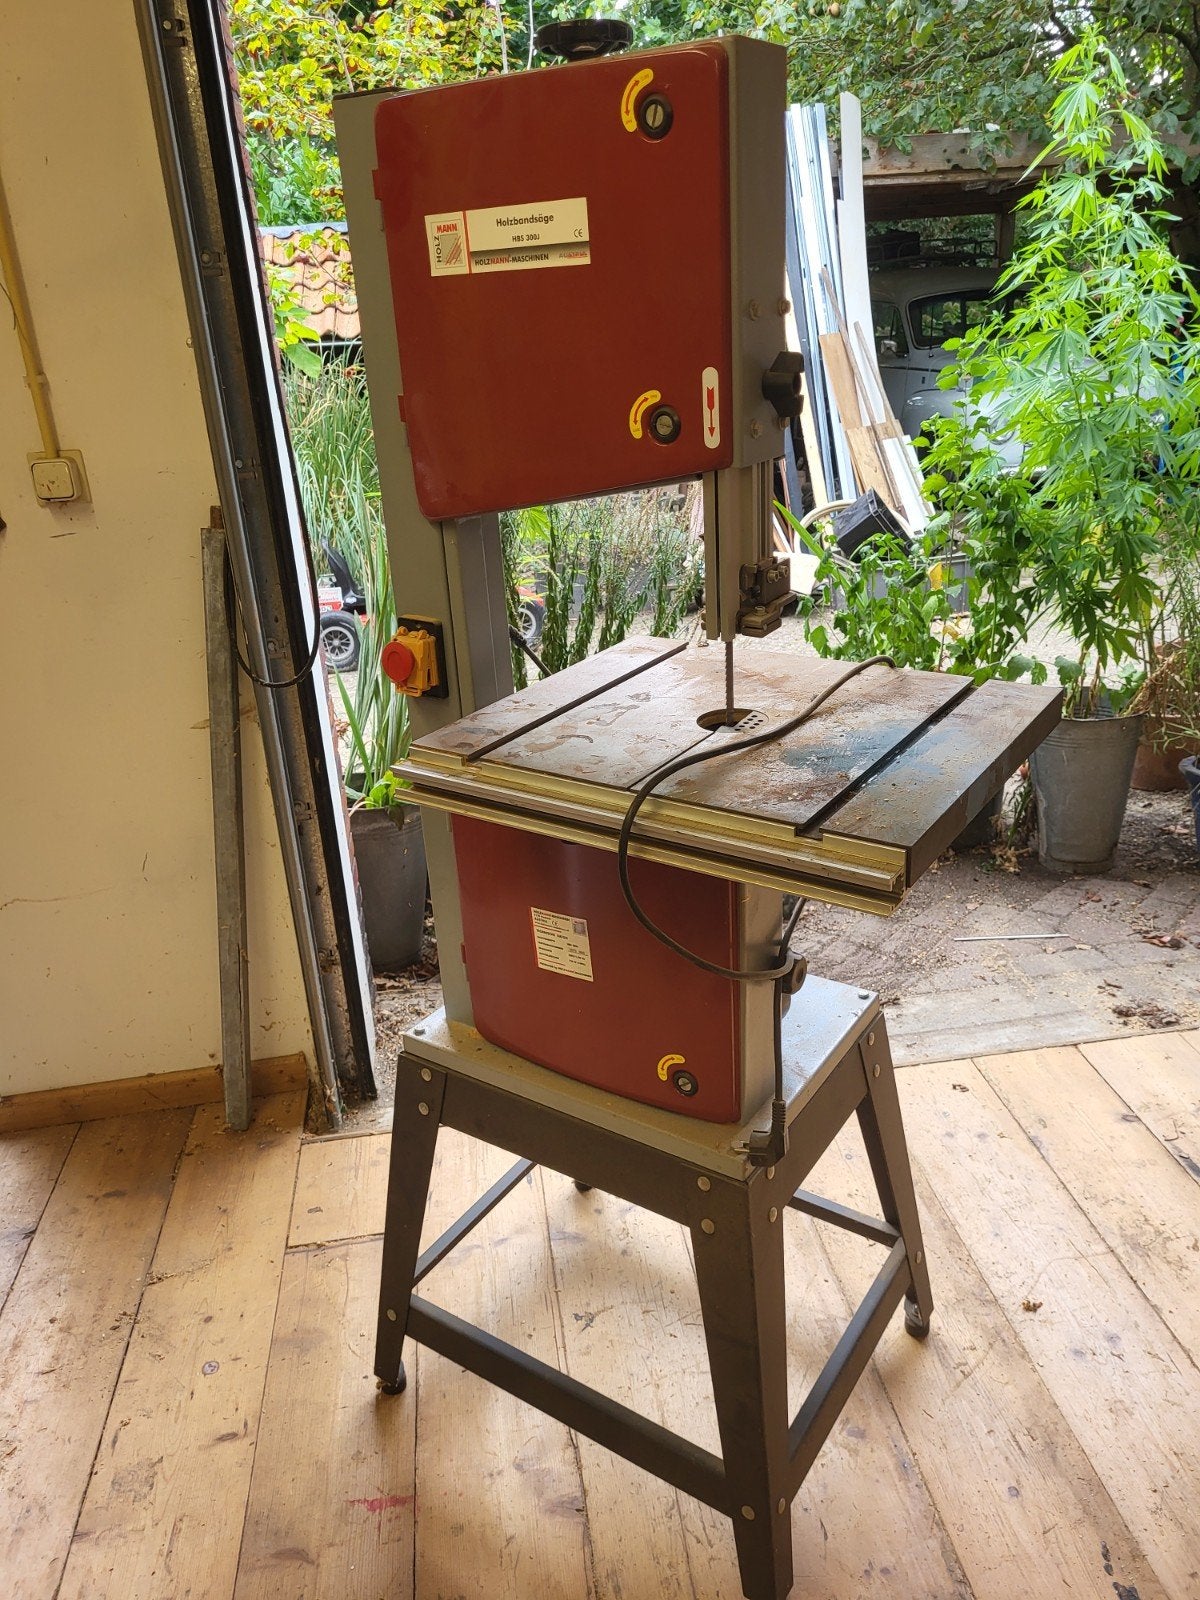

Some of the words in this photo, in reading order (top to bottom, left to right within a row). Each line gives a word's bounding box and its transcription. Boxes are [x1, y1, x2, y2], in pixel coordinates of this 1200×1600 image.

[496, 214, 554, 227] Holzbandsäge
[436, 223, 457, 233] MANN
[573, 228, 583, 238] CE
